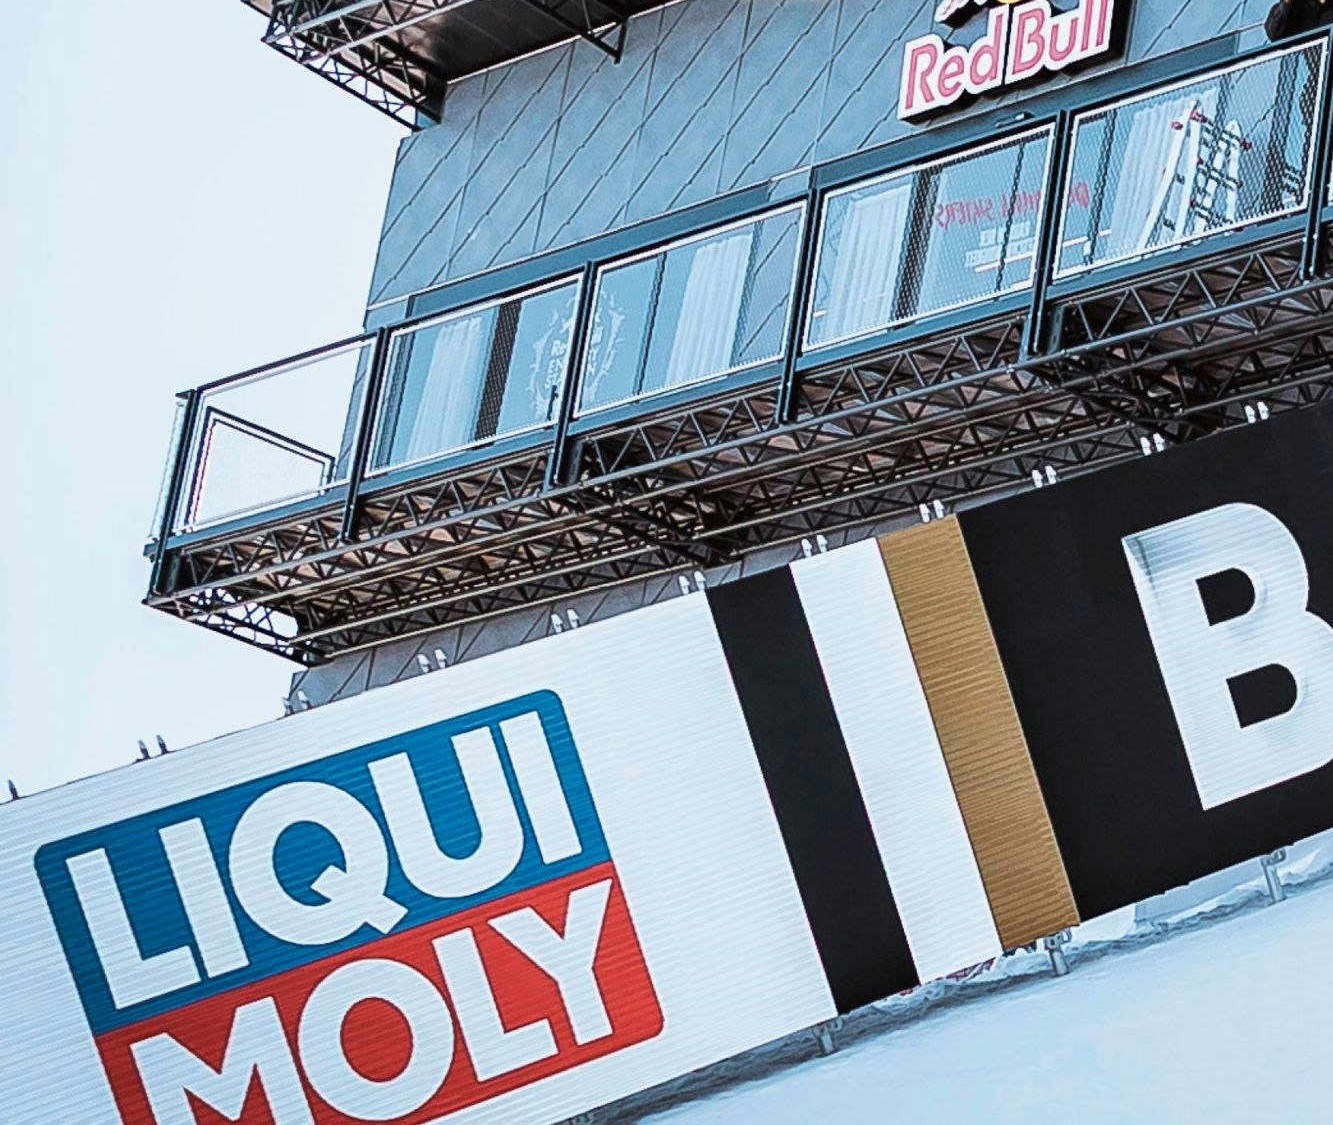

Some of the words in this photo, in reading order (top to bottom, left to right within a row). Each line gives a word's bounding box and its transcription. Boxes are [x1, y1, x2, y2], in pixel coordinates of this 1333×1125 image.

[904, 12, 1004, 110] Red
[65, 710, 583, 1010] LIQUI
[129, 878, 613, 1125] MOLY
